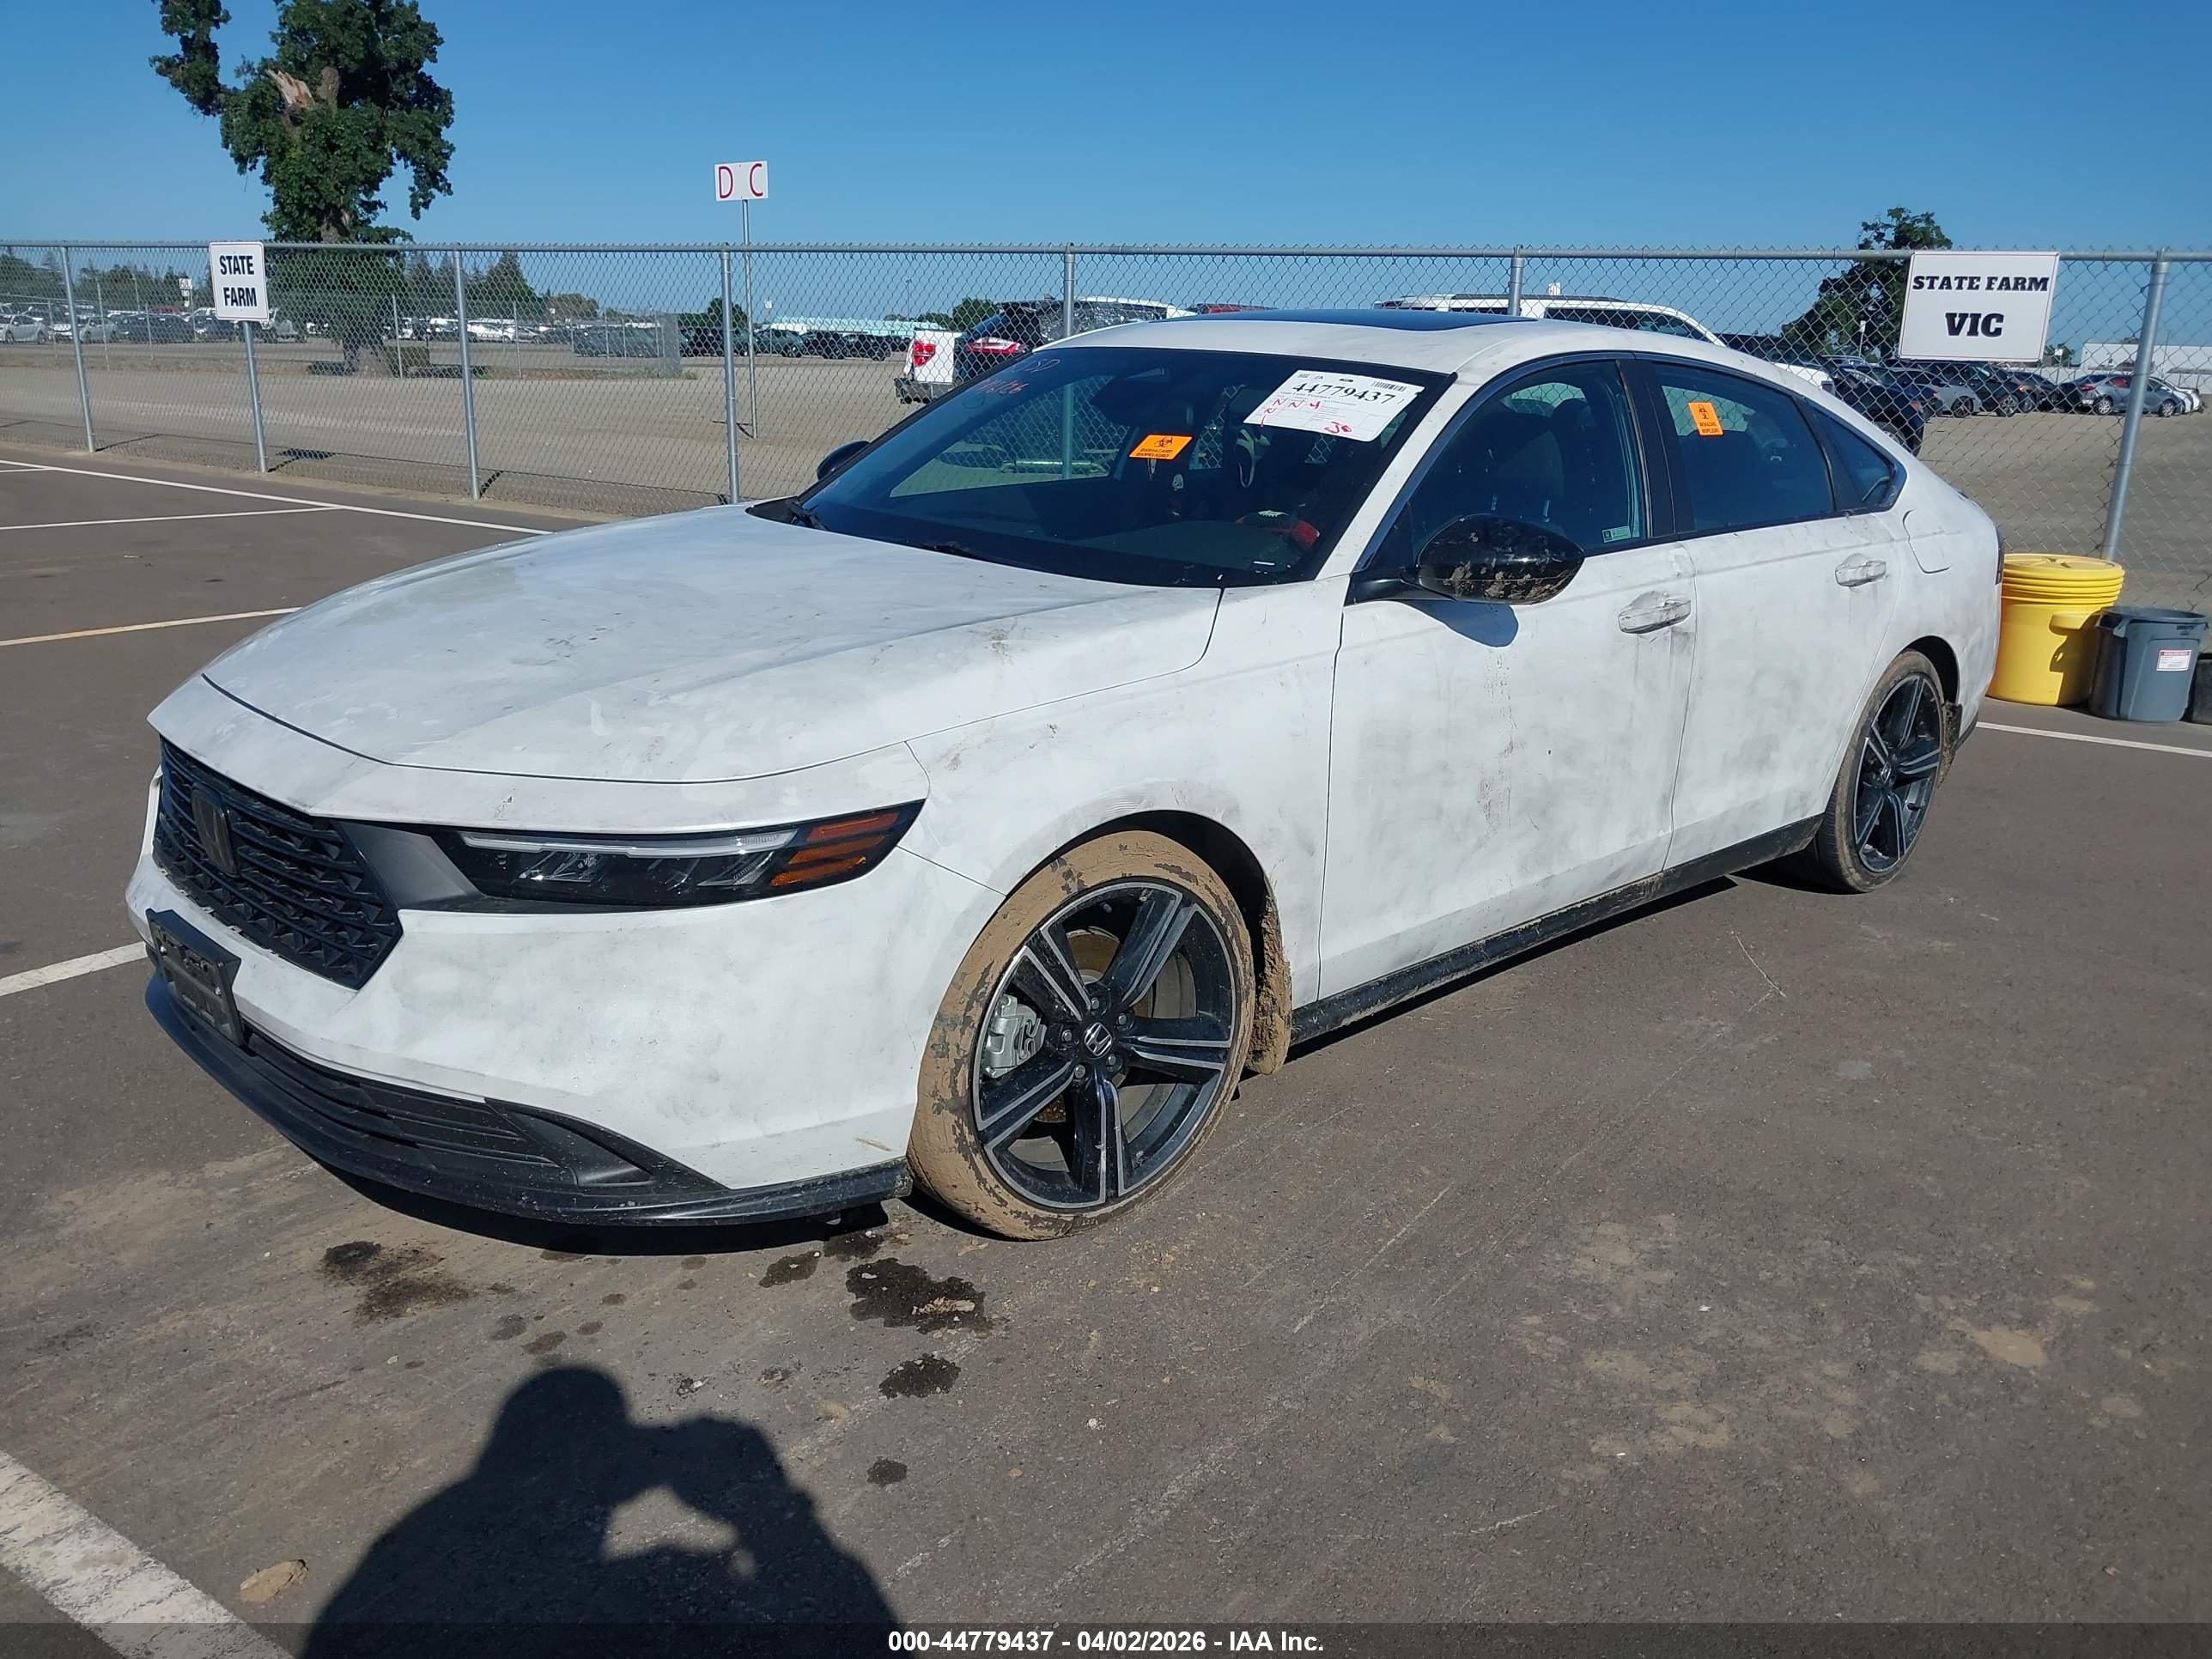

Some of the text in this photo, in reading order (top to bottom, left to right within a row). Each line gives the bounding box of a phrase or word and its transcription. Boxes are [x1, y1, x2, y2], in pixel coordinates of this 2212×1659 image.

[718, 163, 763, 198] D C
[219, 255, 255, 275] STATE
[1912, 275, 2050, 291] STATE FARM
[223, 287, 258, 307] FARM
[1945, 313, 2004, 337] VIC
[1292, 382, 1396, 404] 44779437
